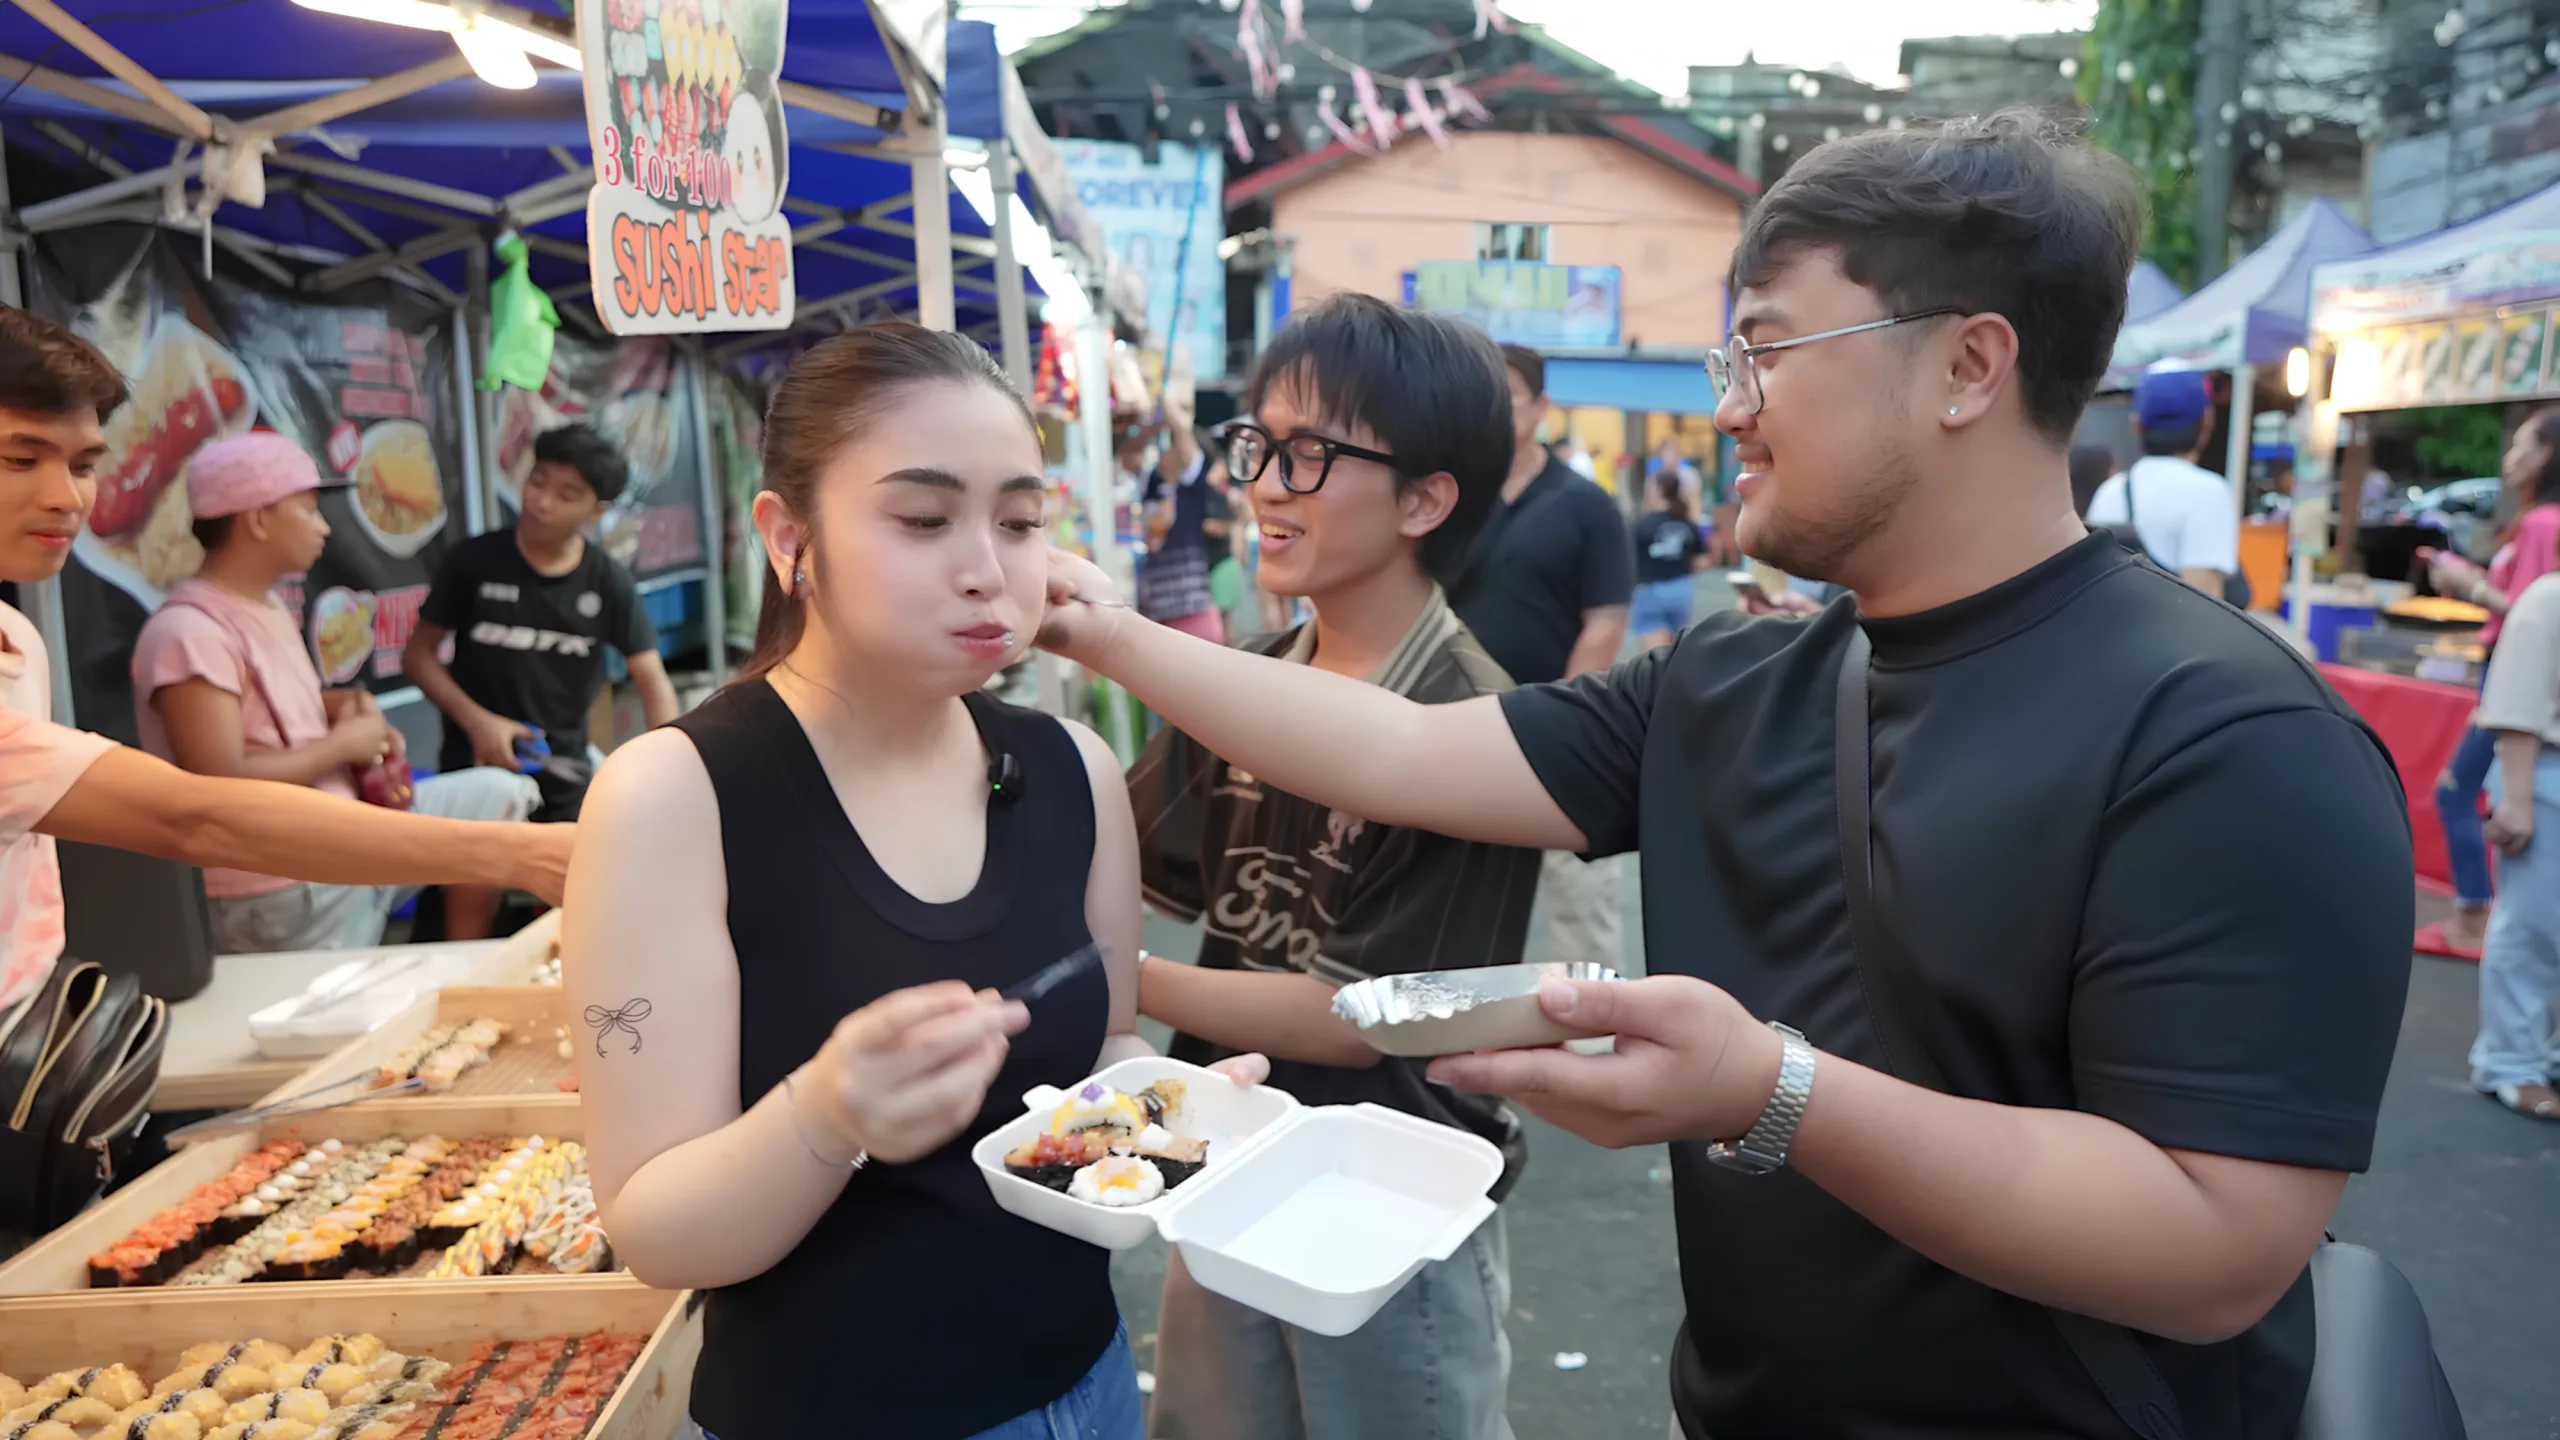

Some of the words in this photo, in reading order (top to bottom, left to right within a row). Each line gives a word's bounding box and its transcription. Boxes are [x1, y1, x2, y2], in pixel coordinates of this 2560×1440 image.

[603, 126, 622, 186] 3
[631, 136, 678, 201] for
[686, 148, 732, 207] 100
[1077, 179, 1210, 208] OREVER
